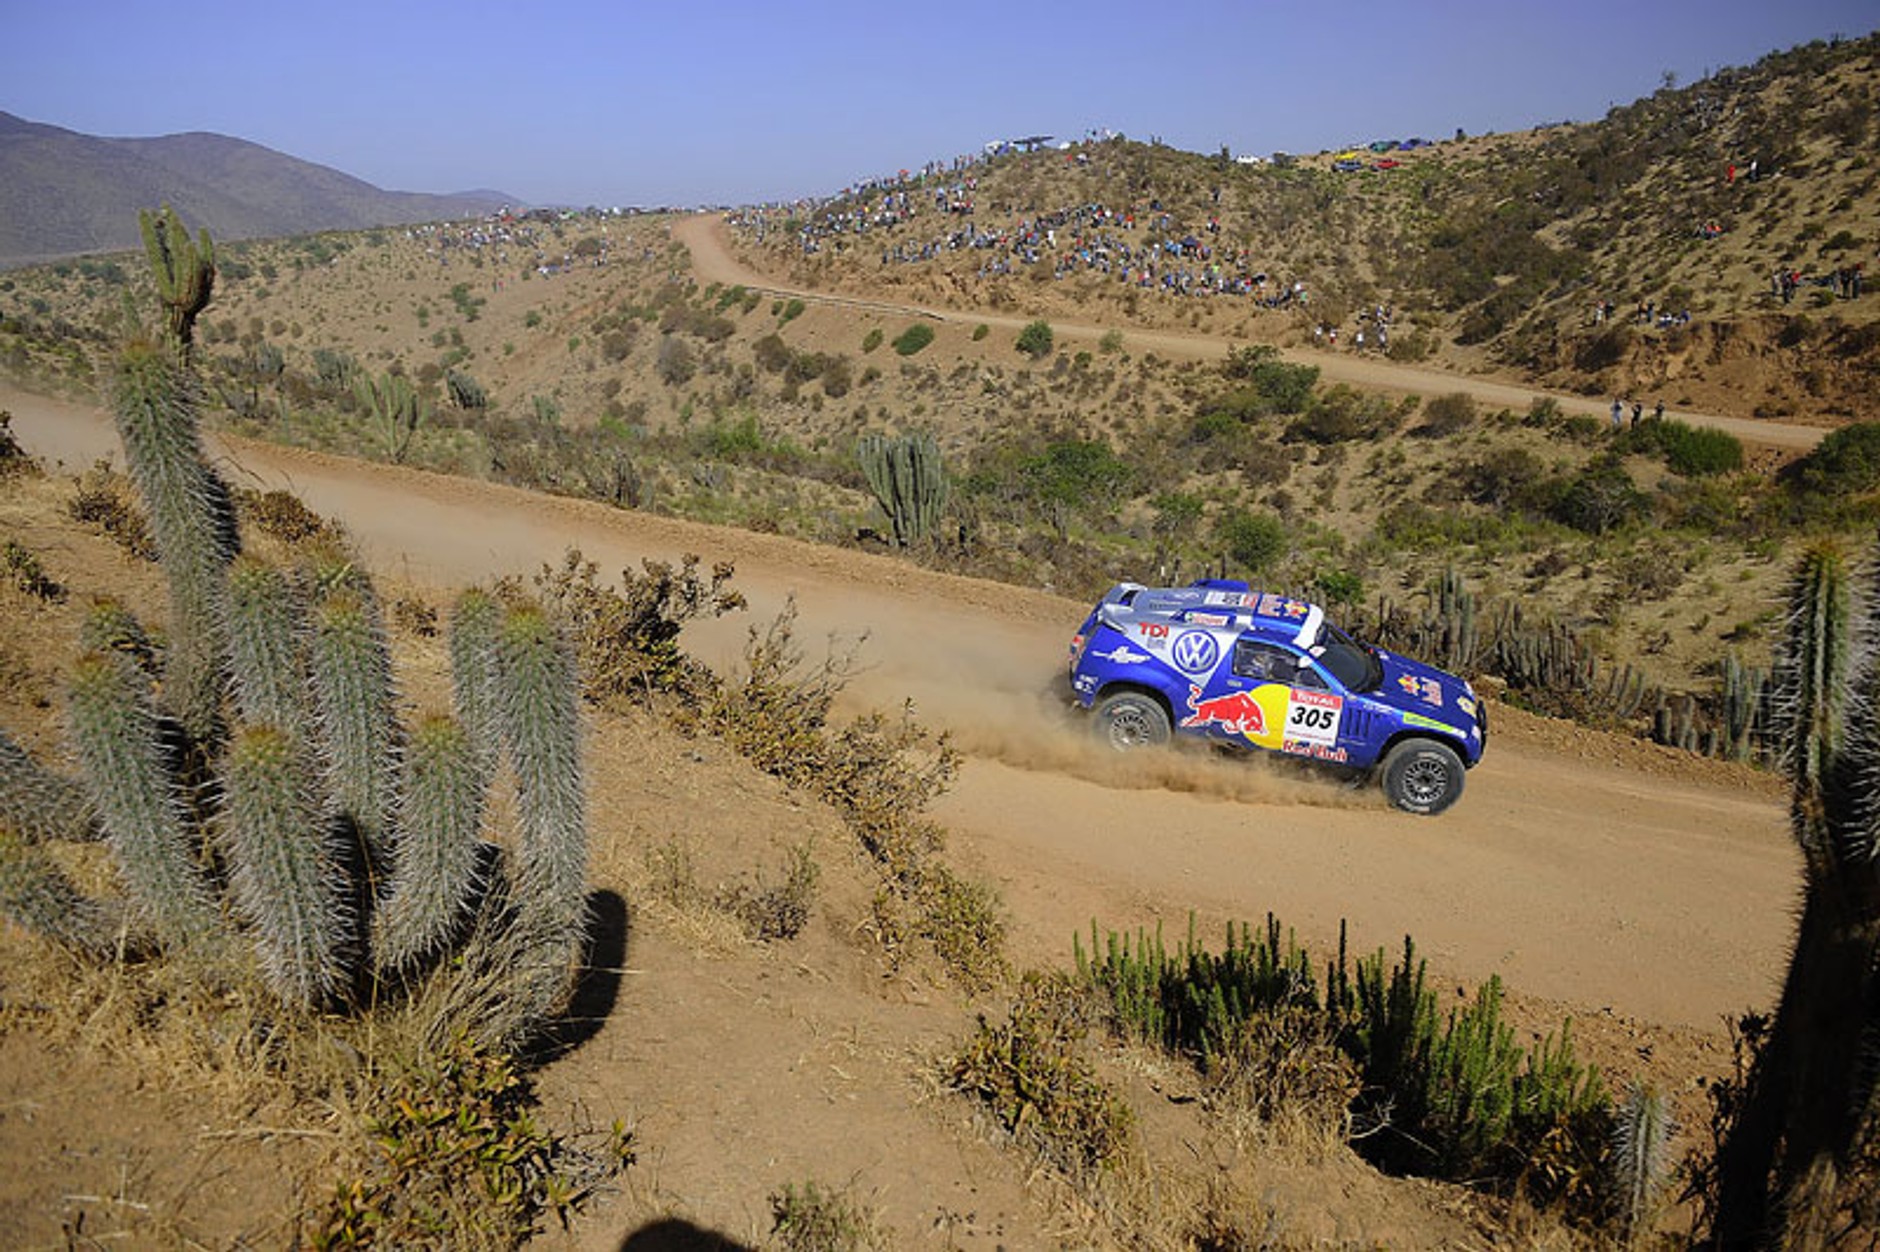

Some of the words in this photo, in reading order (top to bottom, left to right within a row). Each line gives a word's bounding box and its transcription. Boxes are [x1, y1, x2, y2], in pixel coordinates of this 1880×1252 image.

[1139, 622, 1168, 637] TDI
[1297, 694, 1334, 706] TOTAL
[1291, 706, 1335, 729] 305
[1283, 740, 1313, 756] Red
[1314, 744, 1347, 762] Bull
